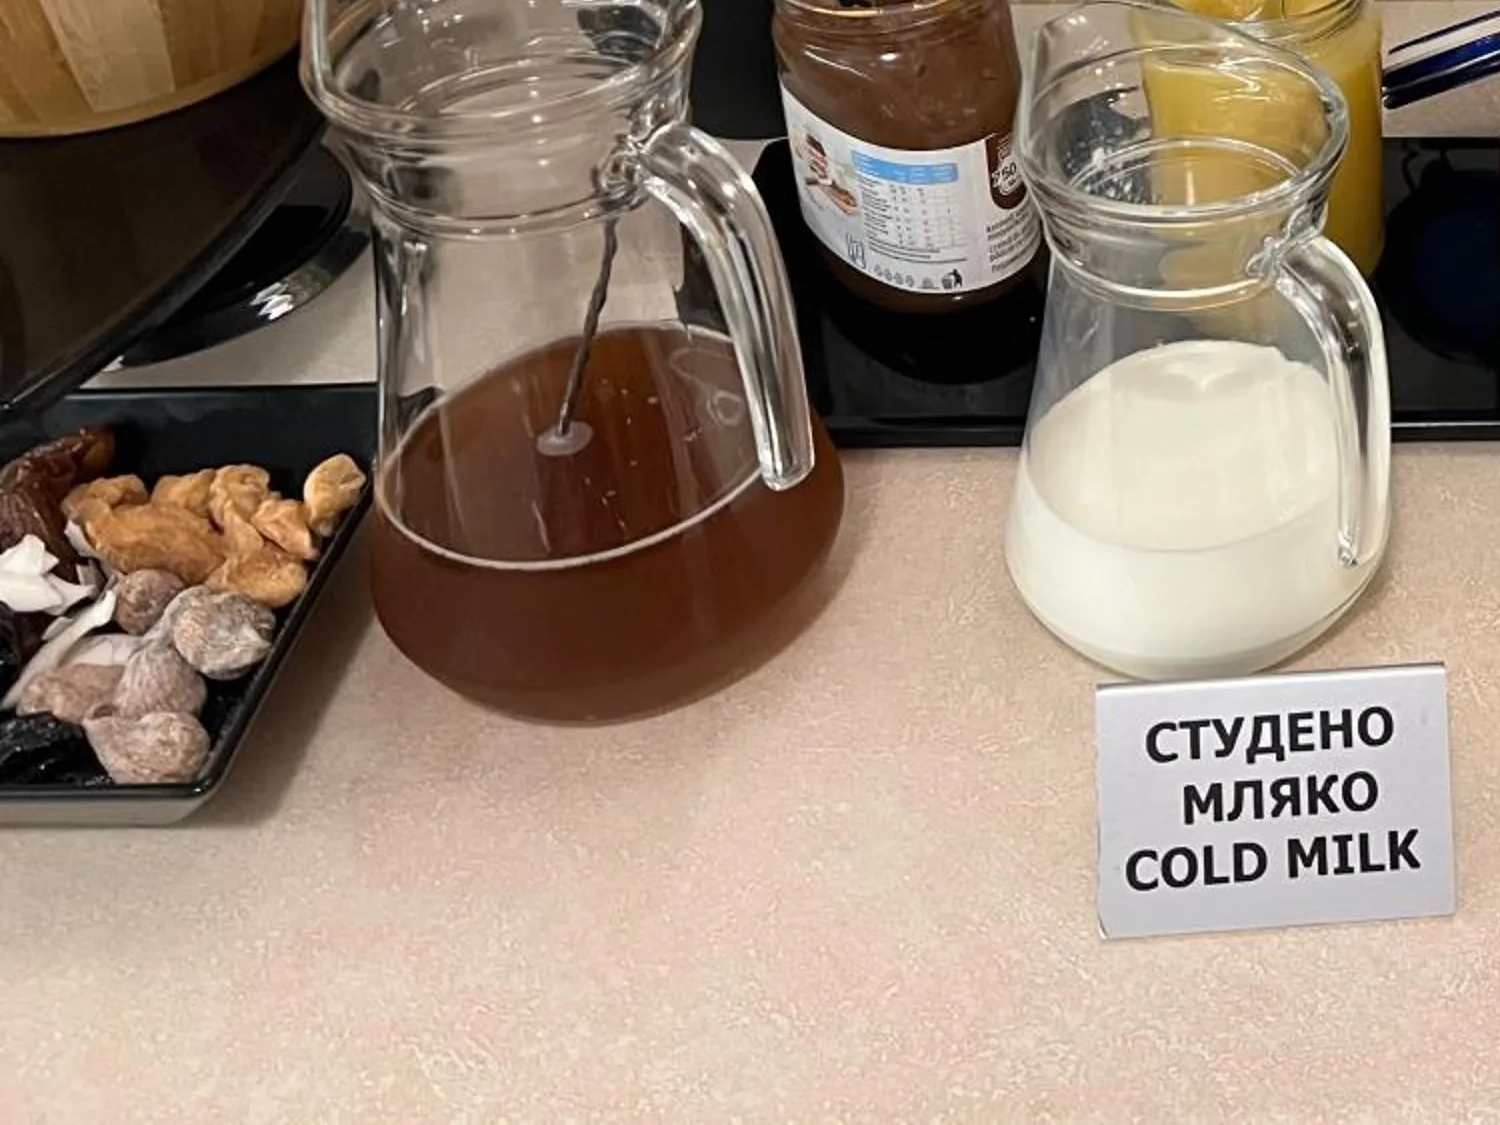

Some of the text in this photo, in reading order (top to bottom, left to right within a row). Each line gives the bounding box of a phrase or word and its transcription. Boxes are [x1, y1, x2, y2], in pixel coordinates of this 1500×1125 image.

[1145, 706, 1394, 764] СТУДЕНО
[1183, 771, 1379, 825] МЛЯКО
[1125, 828, 1421, 891] COLD MILK
